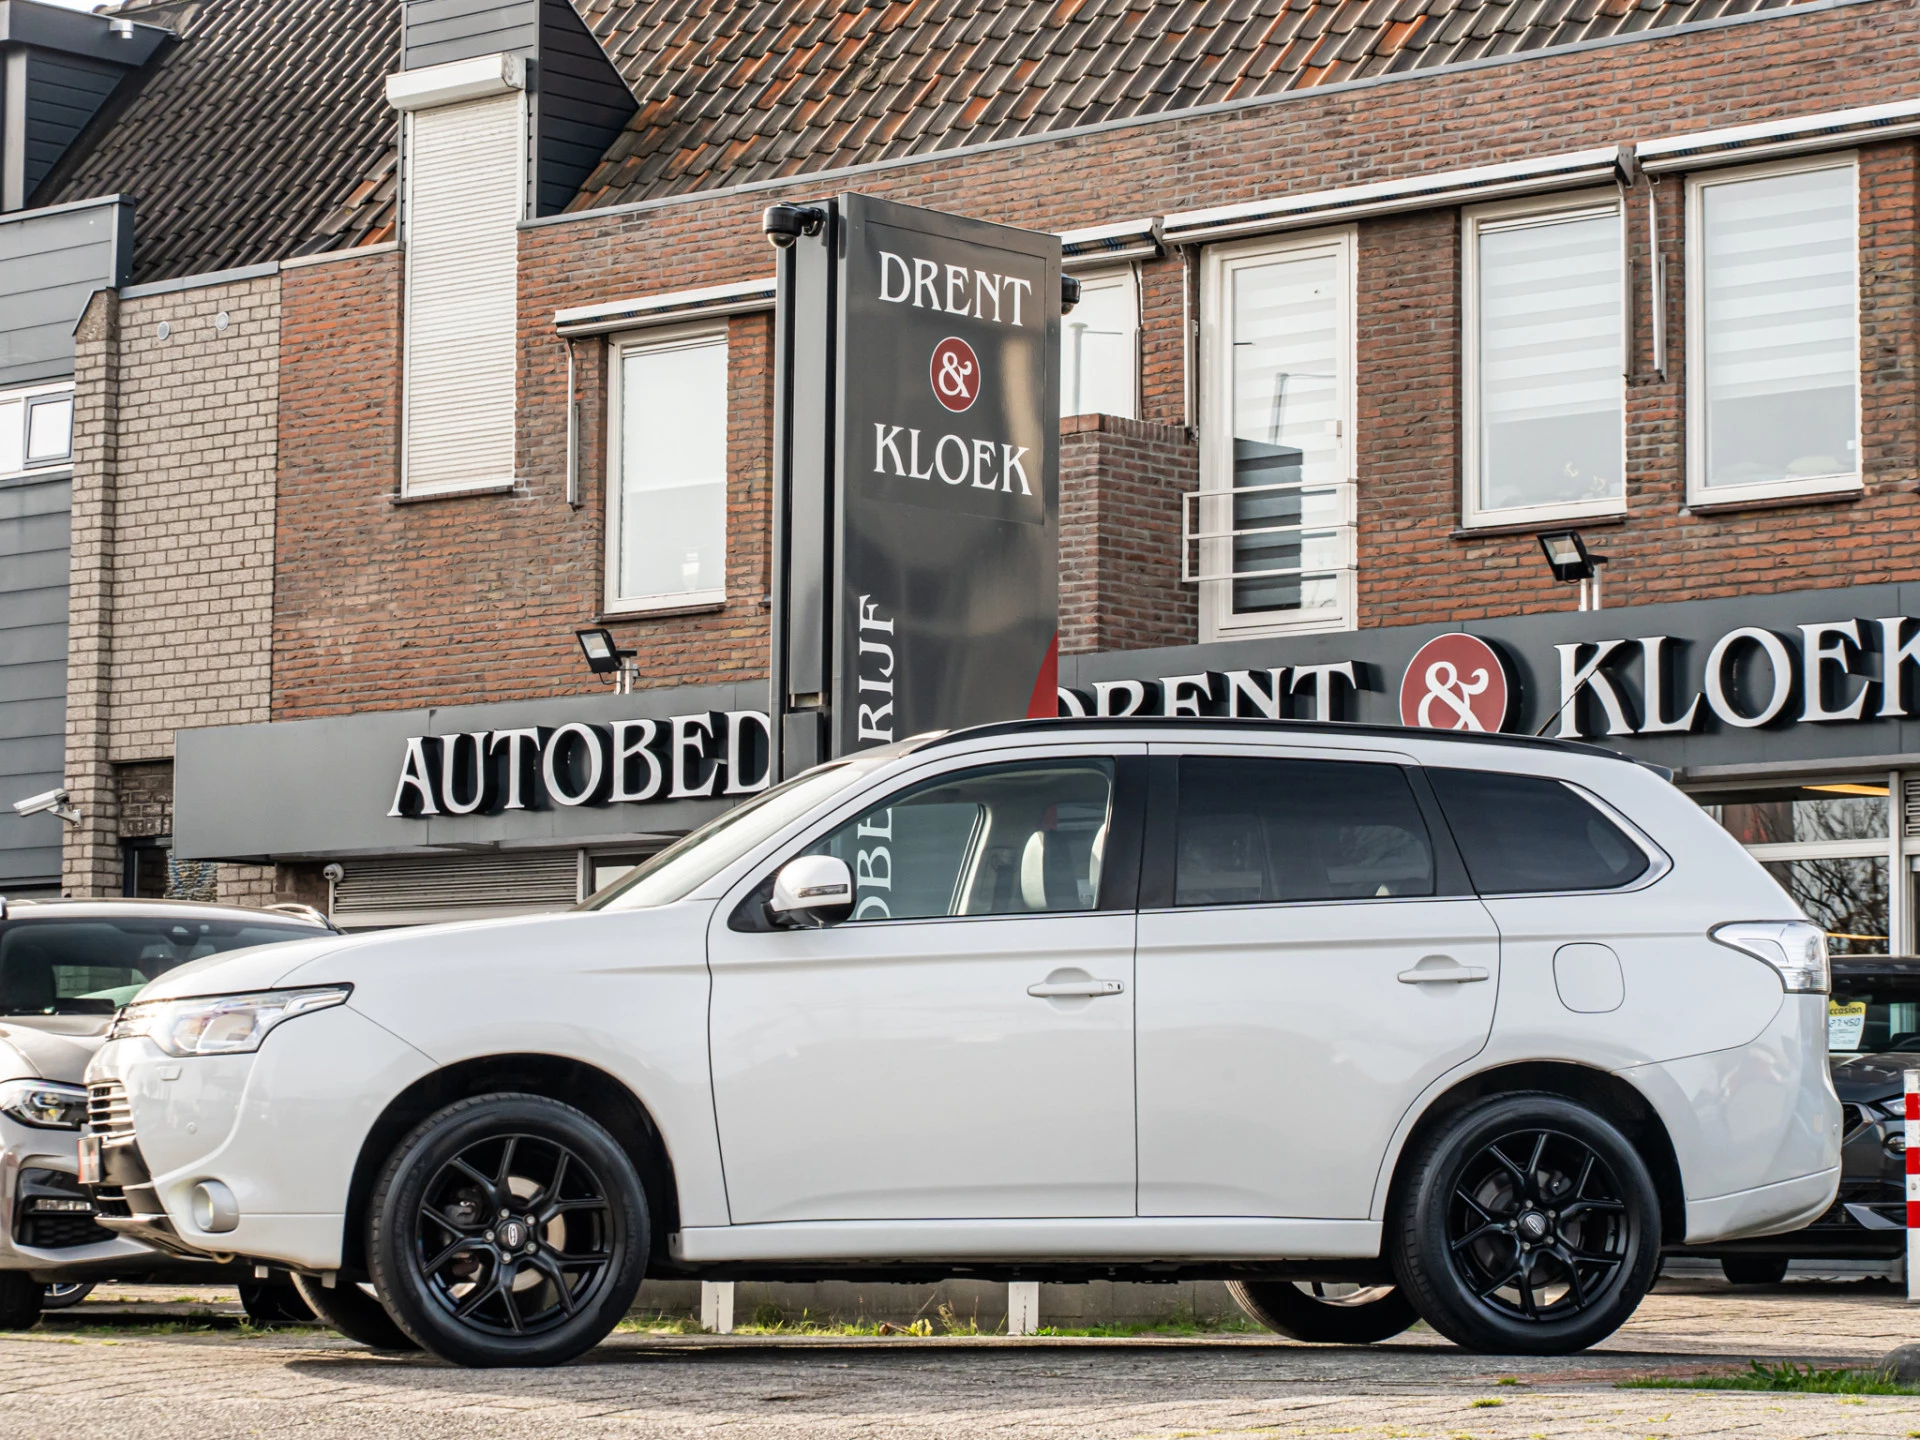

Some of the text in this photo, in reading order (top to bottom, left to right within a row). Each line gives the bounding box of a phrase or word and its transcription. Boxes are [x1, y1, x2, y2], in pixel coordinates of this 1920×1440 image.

[878, 251, 1032, 326] DRENT
[938, 351, 972, 398] &
[873, 422, 1033, 496] KLOEK
[1418, 661, 1488, 733] &
[1829, 1006, 1862, 1015] ccasion
